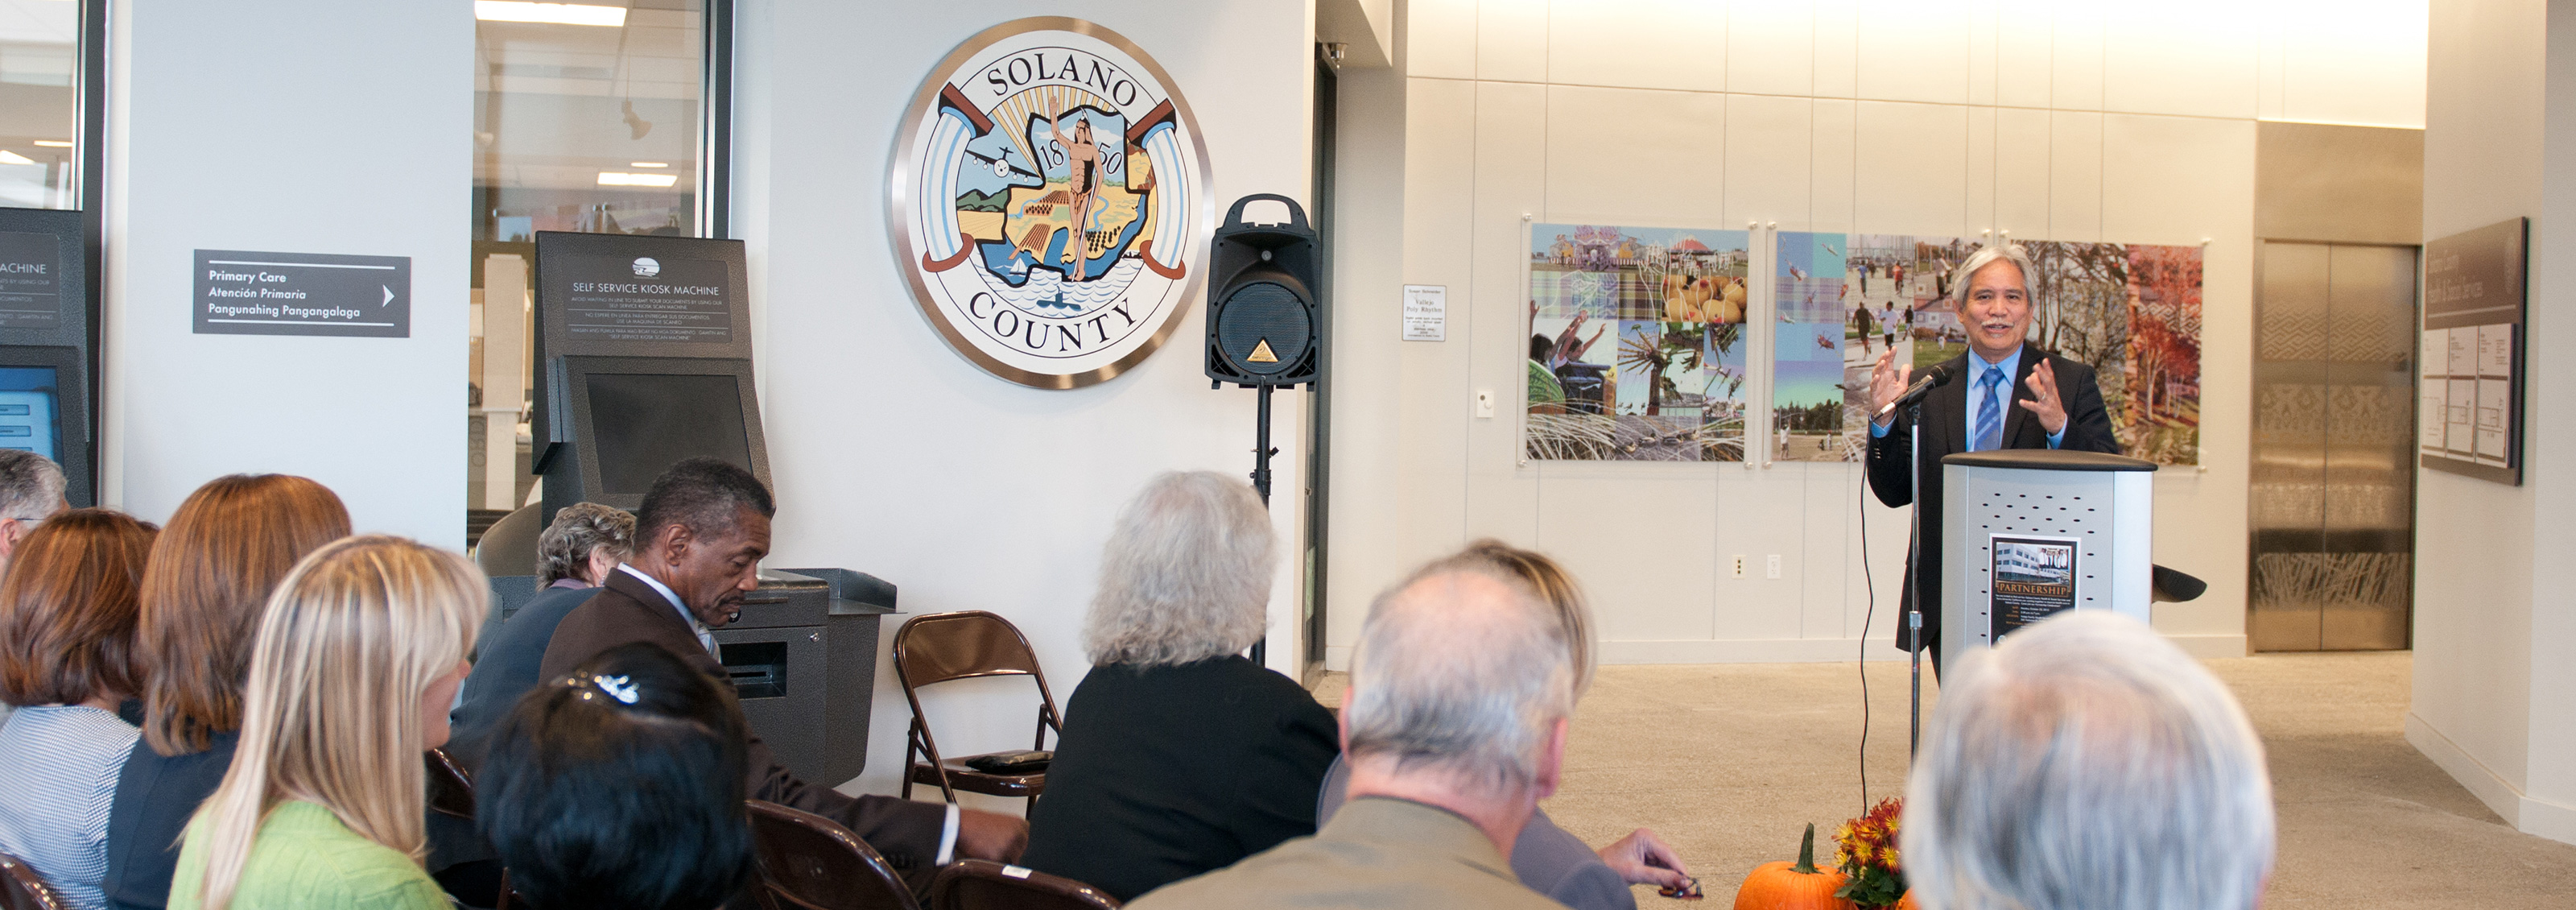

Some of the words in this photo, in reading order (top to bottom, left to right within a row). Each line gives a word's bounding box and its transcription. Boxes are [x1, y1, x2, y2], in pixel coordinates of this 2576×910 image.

[988, 53, 1136, 106] SOLANO
[1040, 139, 1064, 170] 18
[1098, 143, 1122, 174] 50
[0, 263, 47, 274] ACHINE
[208, 270, 255, 284] Primary
[259, 271, 287, 283] Care
[208, 287, 257, 298] Atención
[260, 288, 307, 300] Primaria
[573, 283, 594, 292] SELF
[598, 283, 638, 293] SERVICE
[641, 284, 671, 294] KIOSK
[674, 286, 719, 296] MACHINE
[208, 303, 279, 317] Pangunahing
[283, 304, 361, 319] Pangangalaga
[969, 292, 1137, 352] COUNTY
[2000, 583, 2066, 595] PARTNERSHIP
